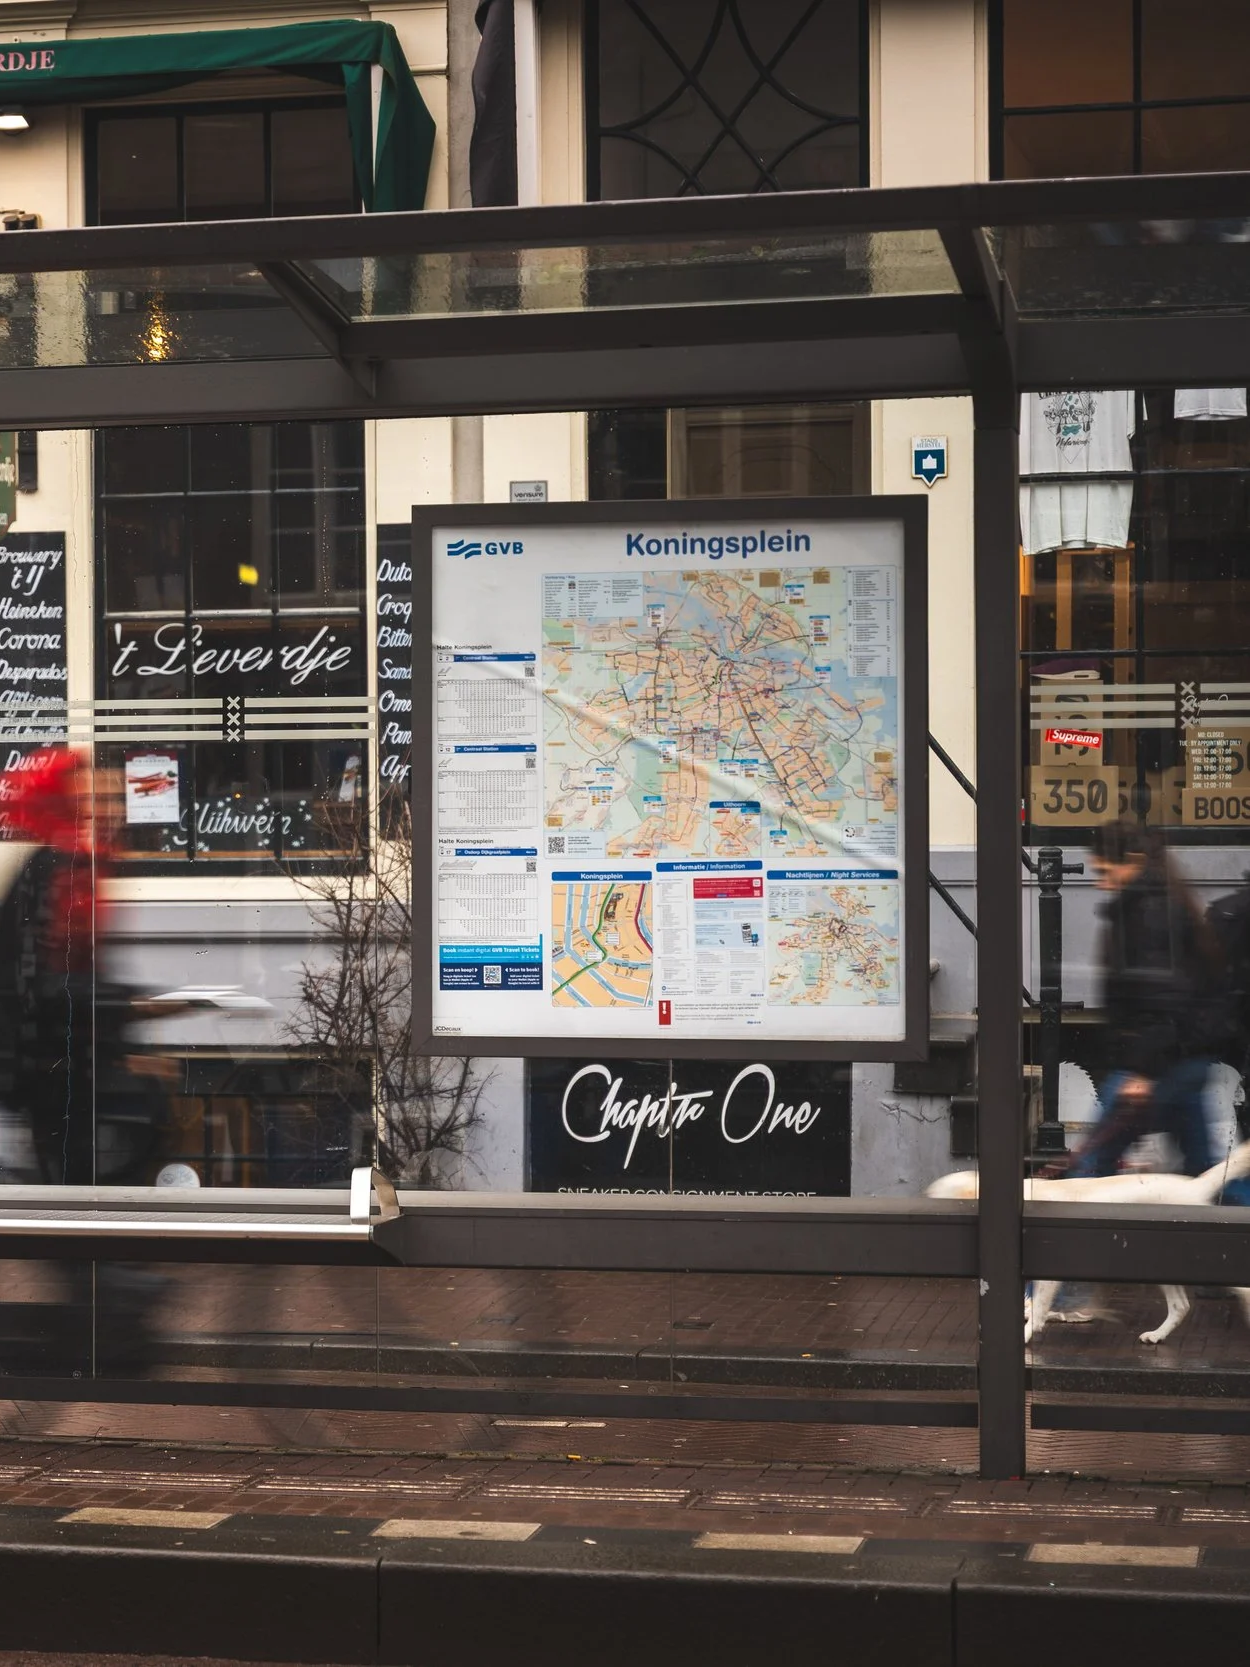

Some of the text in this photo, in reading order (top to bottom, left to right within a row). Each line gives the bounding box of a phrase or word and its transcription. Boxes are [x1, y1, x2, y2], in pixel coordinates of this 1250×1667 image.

[484, 541, 524, 555] GVB
[626, 529, 811, 560] Koningsplein
[112, 623, 138, 677] 't
[1052, 729, 1100, 744] Supreme
[1043, 778, 1108, 814] 350
[721, 1063, 821, 1143] One
